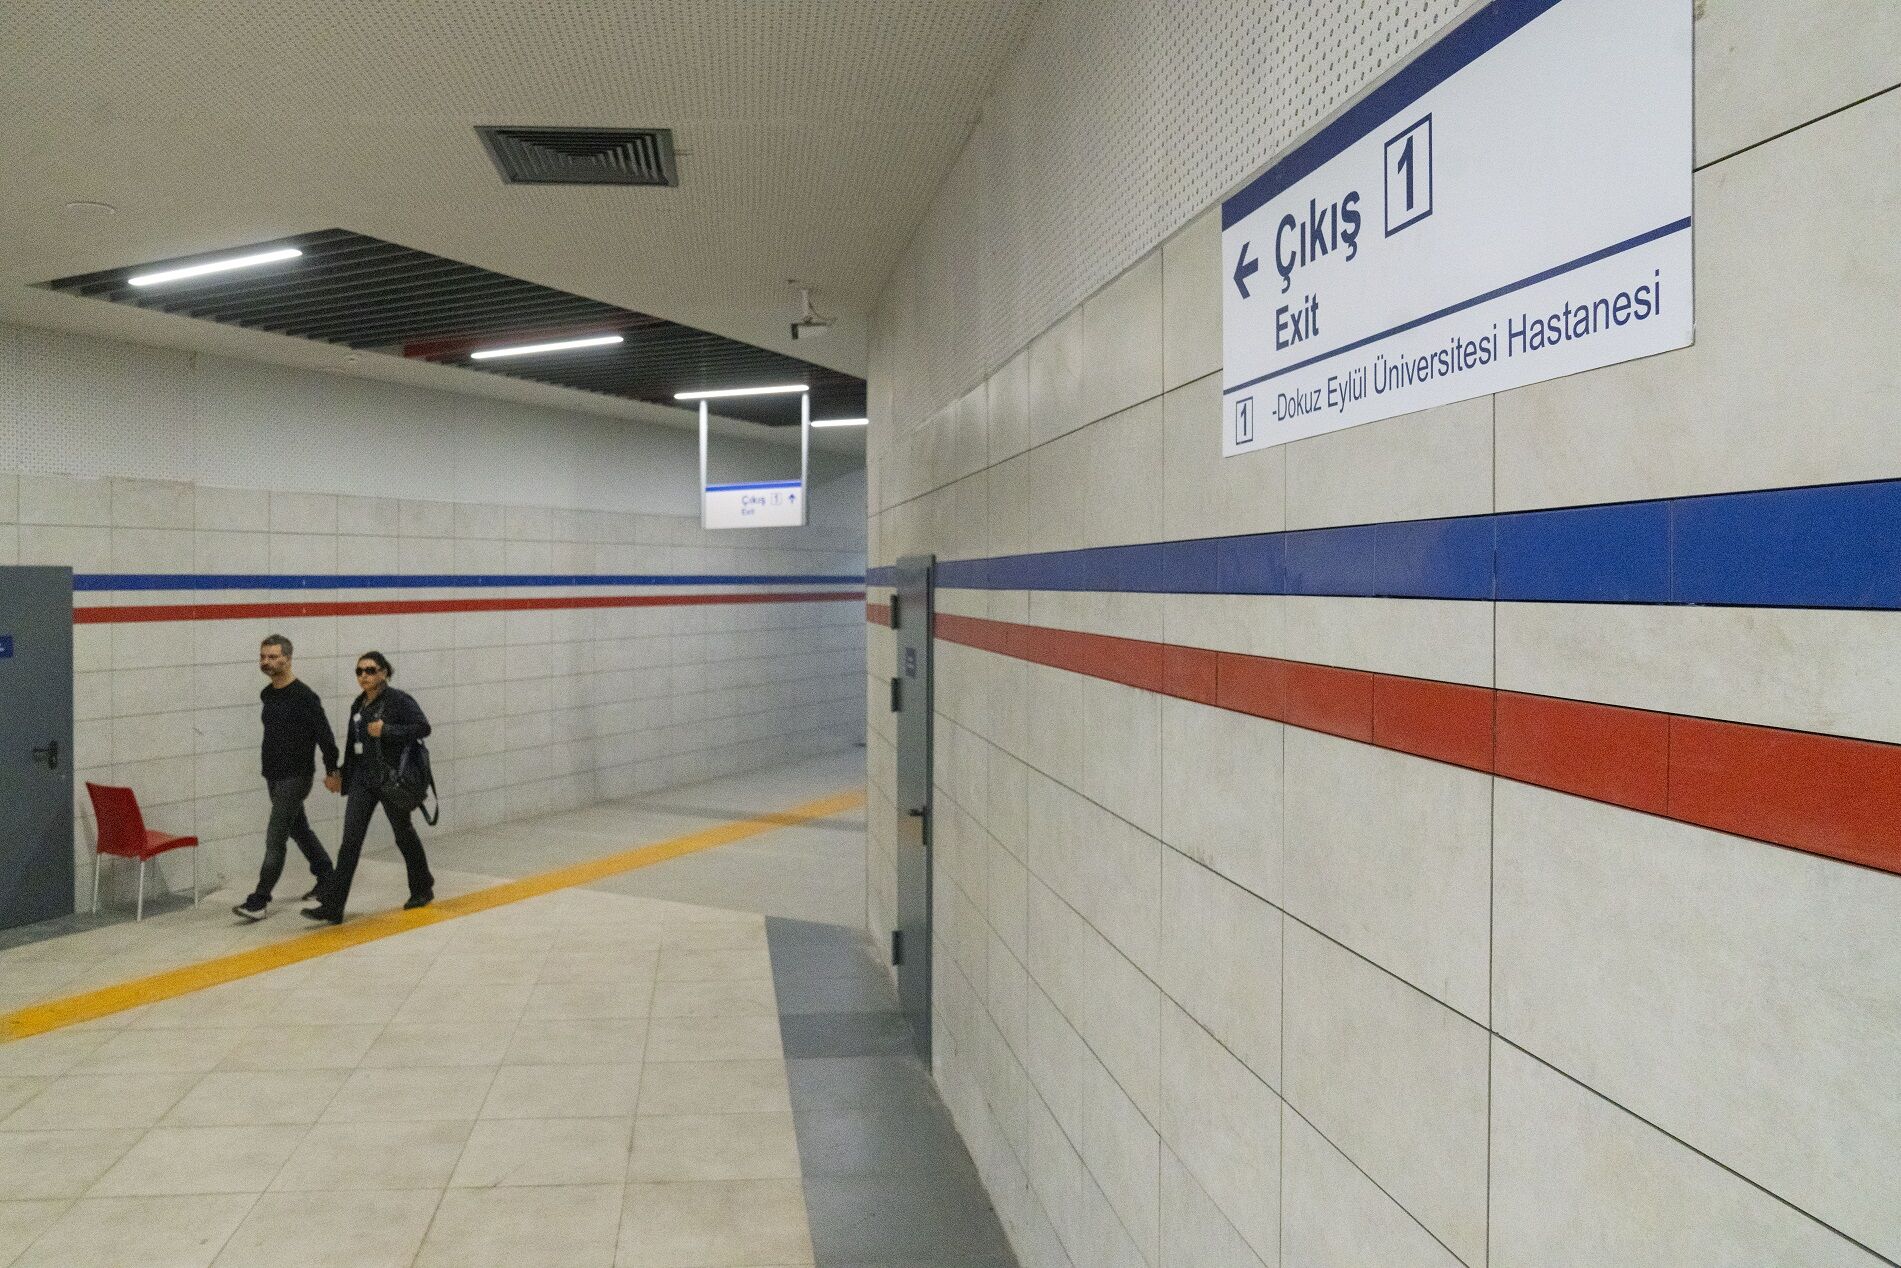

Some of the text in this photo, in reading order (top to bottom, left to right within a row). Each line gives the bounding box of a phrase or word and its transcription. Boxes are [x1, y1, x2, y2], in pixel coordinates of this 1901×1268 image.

[1275, 135, 1414, 293] Çıkış 1
[1239, 269, 1661, 437] 1 -Dokuz Eylül Üniversitesi Hastanesi
[1275, 293, 1319, 351] Exit
